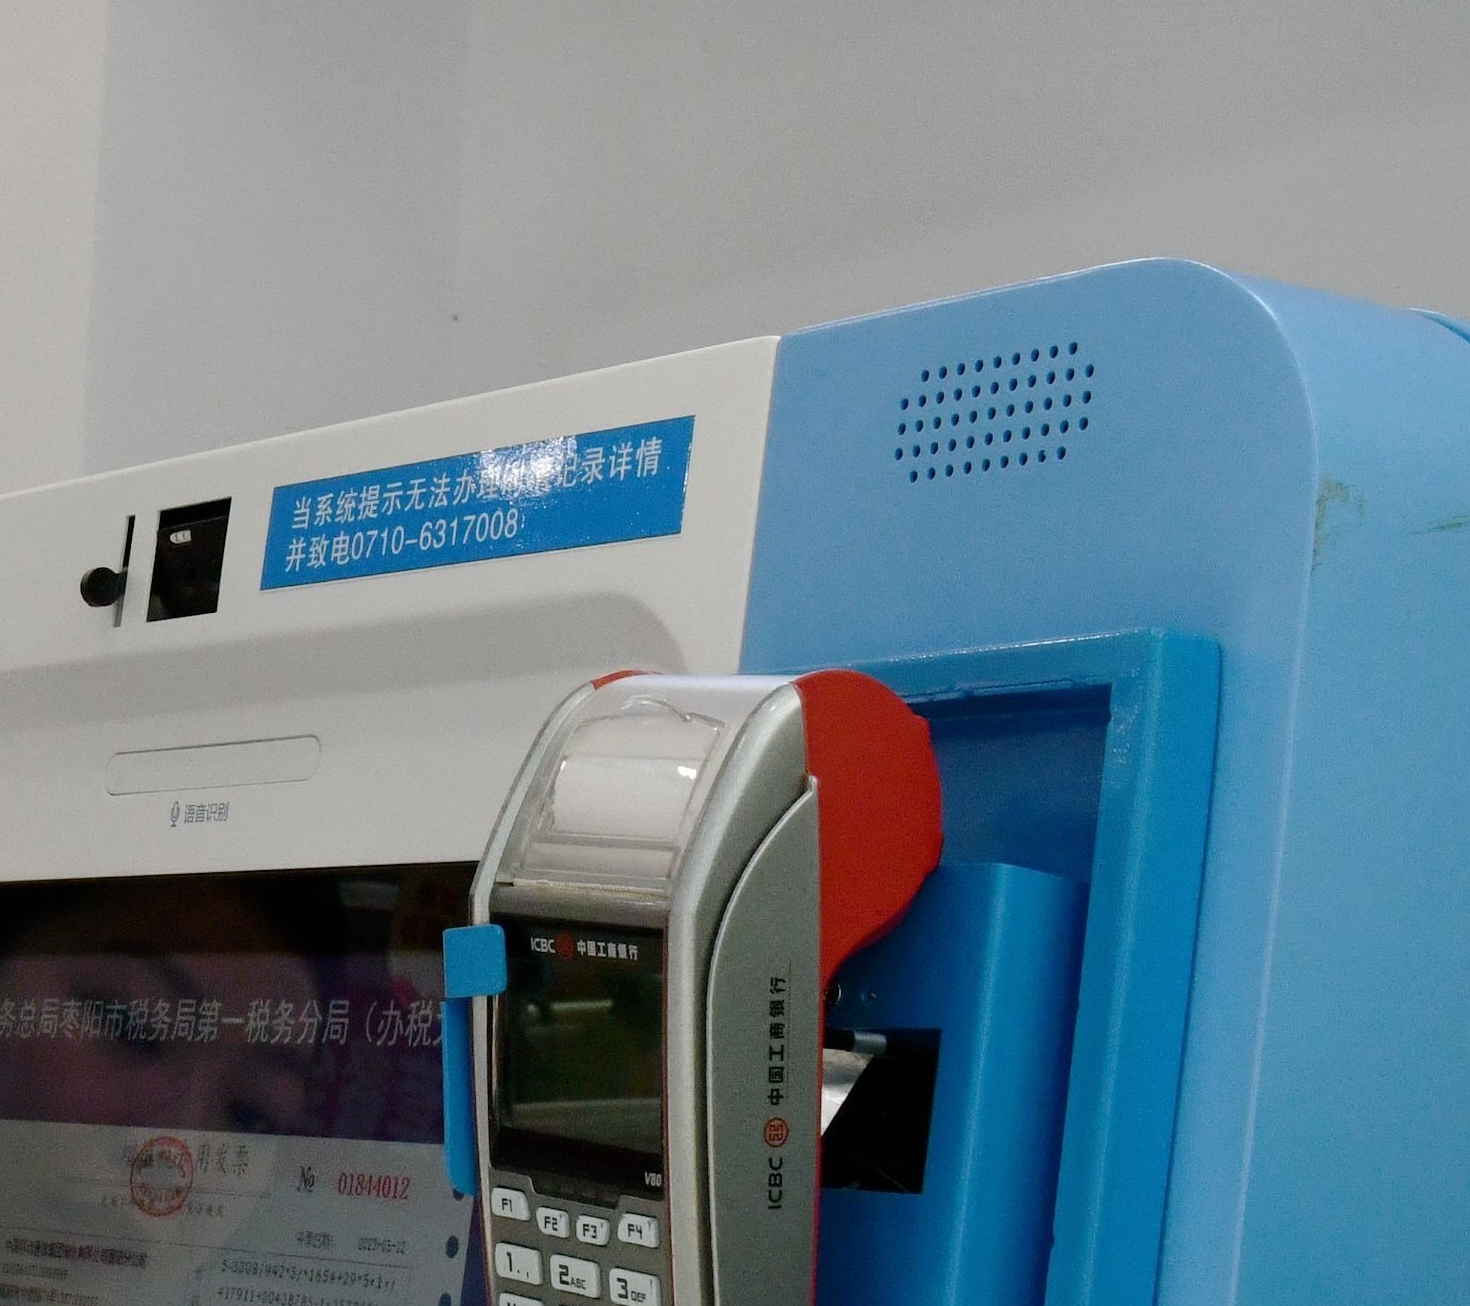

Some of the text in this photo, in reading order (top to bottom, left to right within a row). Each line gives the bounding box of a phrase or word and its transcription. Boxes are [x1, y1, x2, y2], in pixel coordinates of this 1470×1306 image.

[292, 438, 664, 530] 当系统提示无法办理记录详情
[285, 509, 519, 574] 并致电0710-6317008
[184, 801, 230, 824] 语音识别
[768, 976, 787, 1107] 中国工商银行
[768, 1156, 784, 1210] ICBC
[500, 1197, 514, 1214] F1
[543, 1215, 559, 1232] F2
[582, 1222, 599, 1240] F3
[627, 1222, 644, 1240] F4
